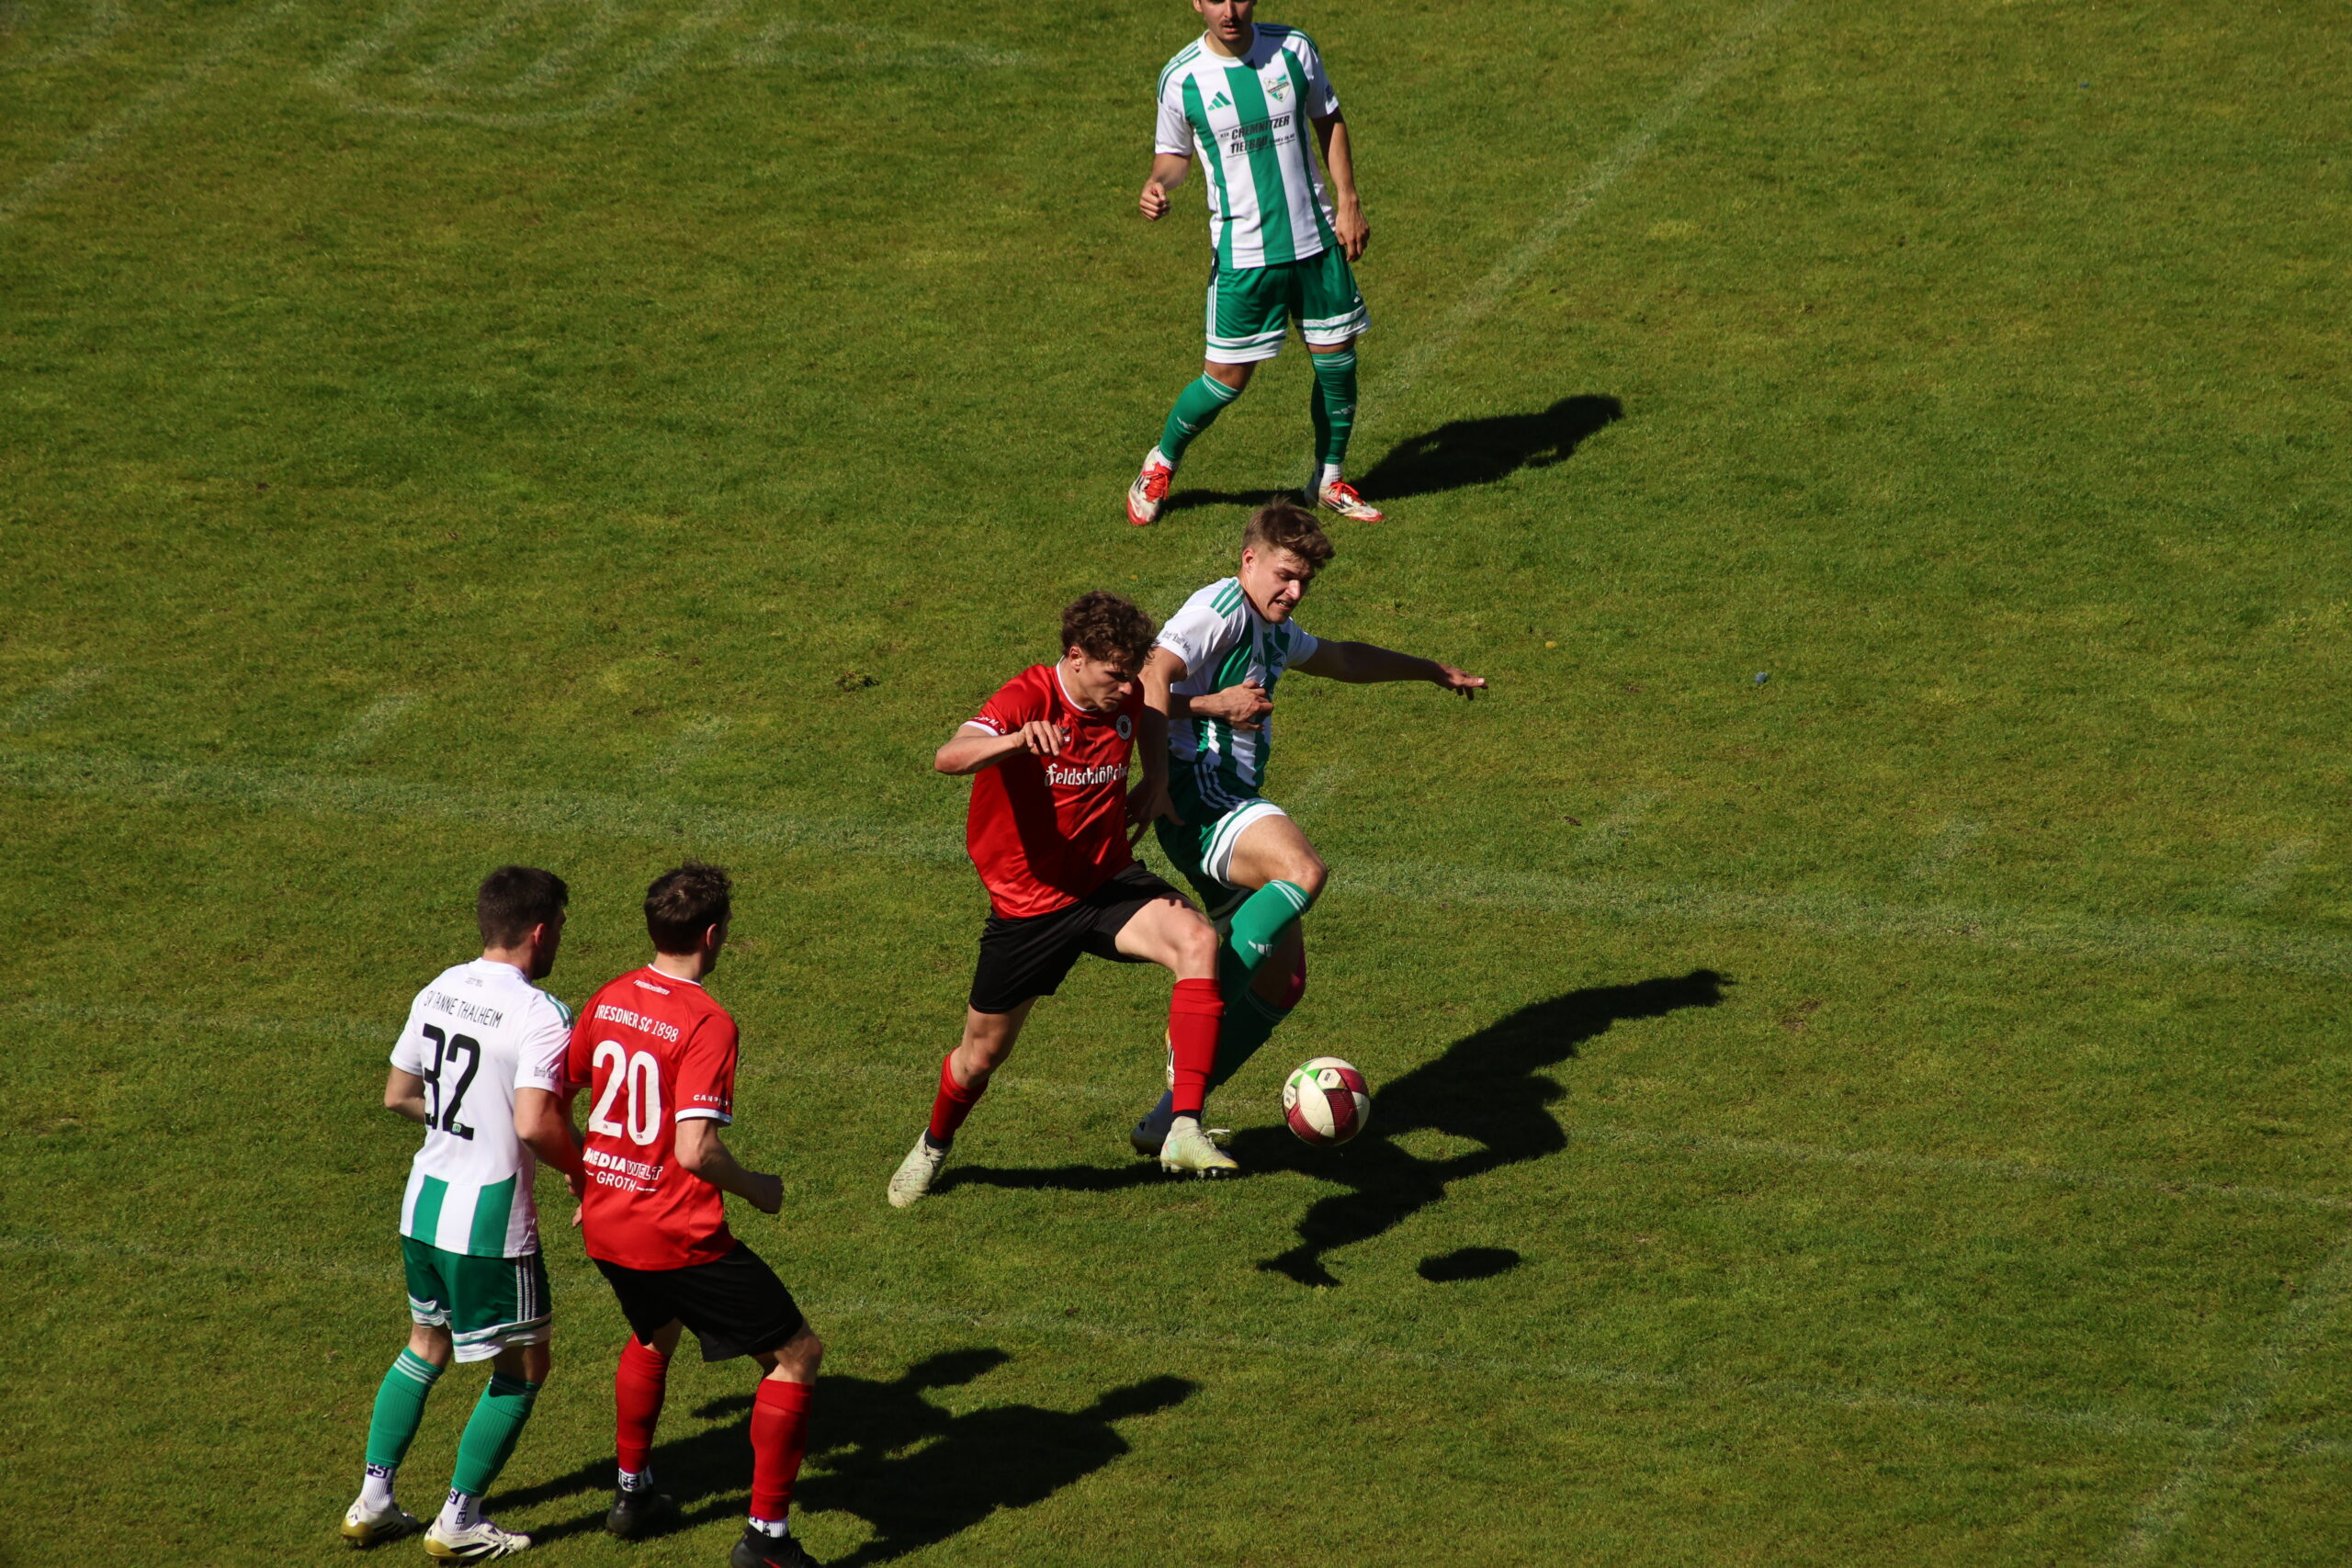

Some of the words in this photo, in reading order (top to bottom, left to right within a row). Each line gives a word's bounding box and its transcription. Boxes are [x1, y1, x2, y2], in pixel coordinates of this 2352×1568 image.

[1231, 115, 1290, 140] CHEMNITZER
[1044, 762, 1128, 787] Feldschlößch
[458, 1000, 503, 1029] THALHEIM
[638, 1016, 653, 1032] SC
[650, 1021, 679, 1043] 1898
[423, 1022, 481, 1141] 32
[588, 1040, 662, 1145] 20
[596, 1170, 637, 1192] GROTH
